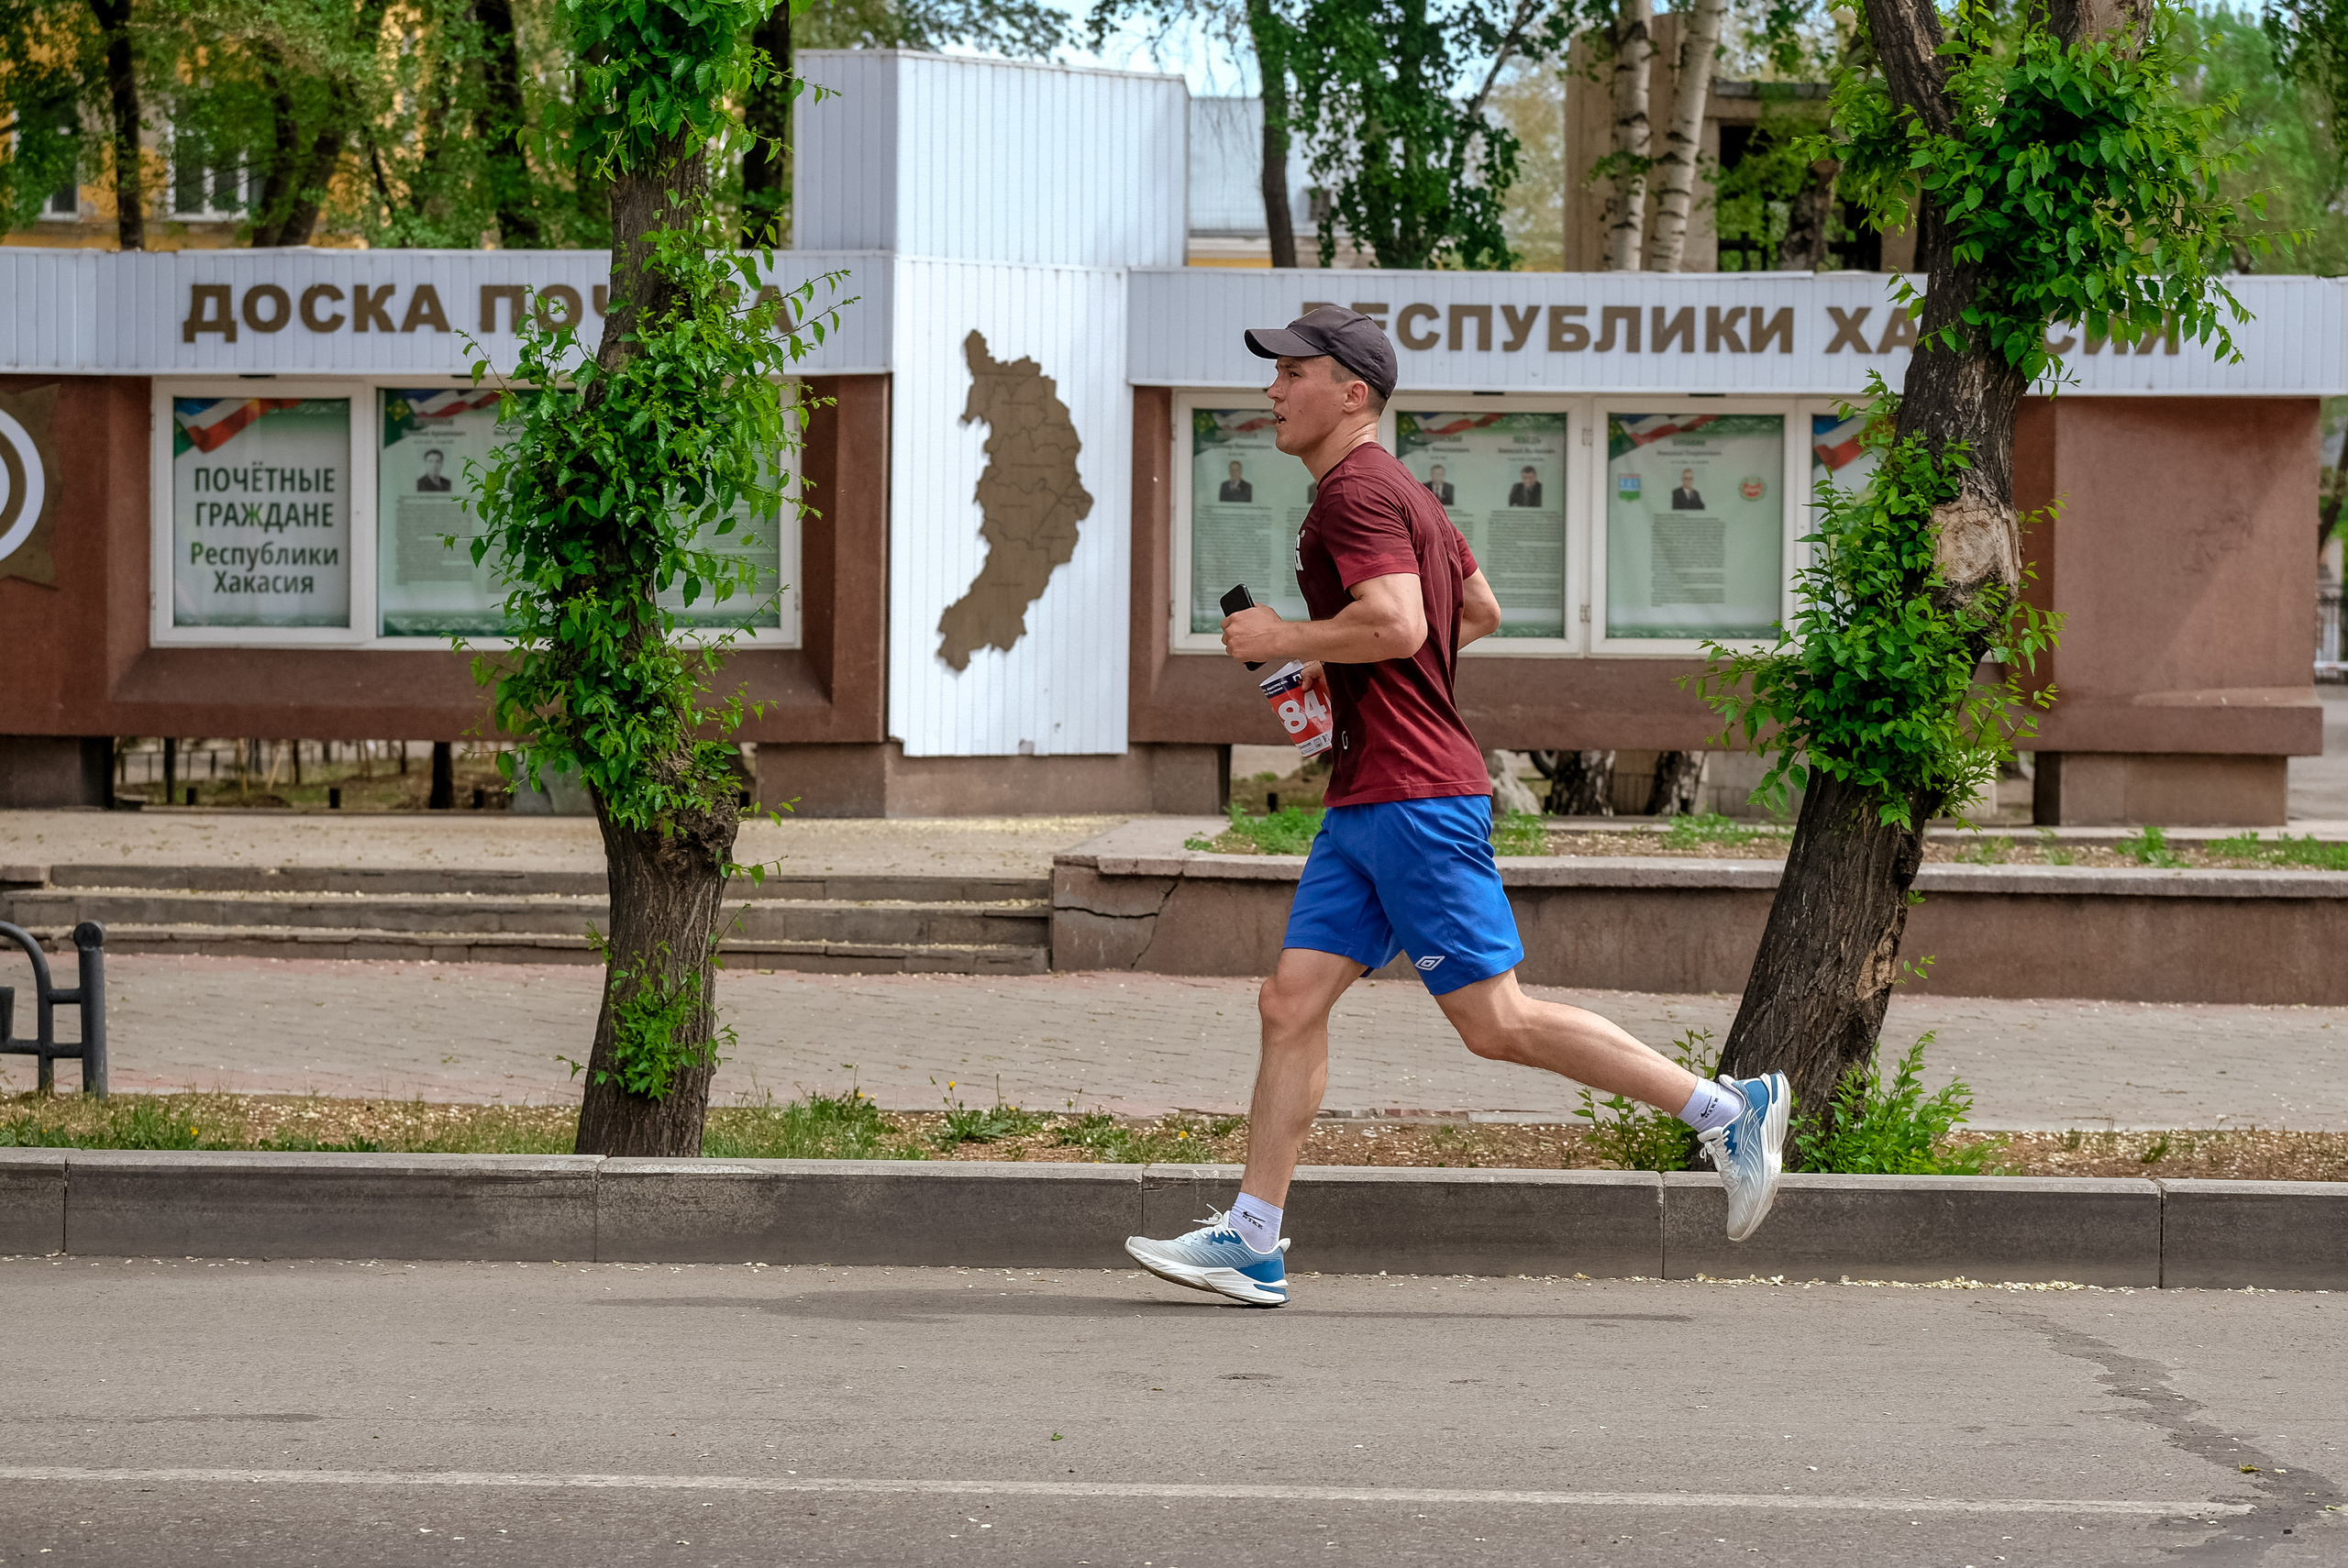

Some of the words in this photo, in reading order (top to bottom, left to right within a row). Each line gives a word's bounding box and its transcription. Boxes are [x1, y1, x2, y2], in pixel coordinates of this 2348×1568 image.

[182, 282, 451, 344] ДОСКА
[1300, 301, 1795, 355] СПУБЛИКИ
[1823, 305, 2181, 356] ХАСИЯ
[194, 460, 336, 493] ПОЧЁТНЫЕ
[194, 502, 335, 534] ГРАЖДАНЕ
[190, 540, 339, 572] Республики
[213, 569, 315, 594] Хакасия
[1278, 690, 1326, 734] 84
